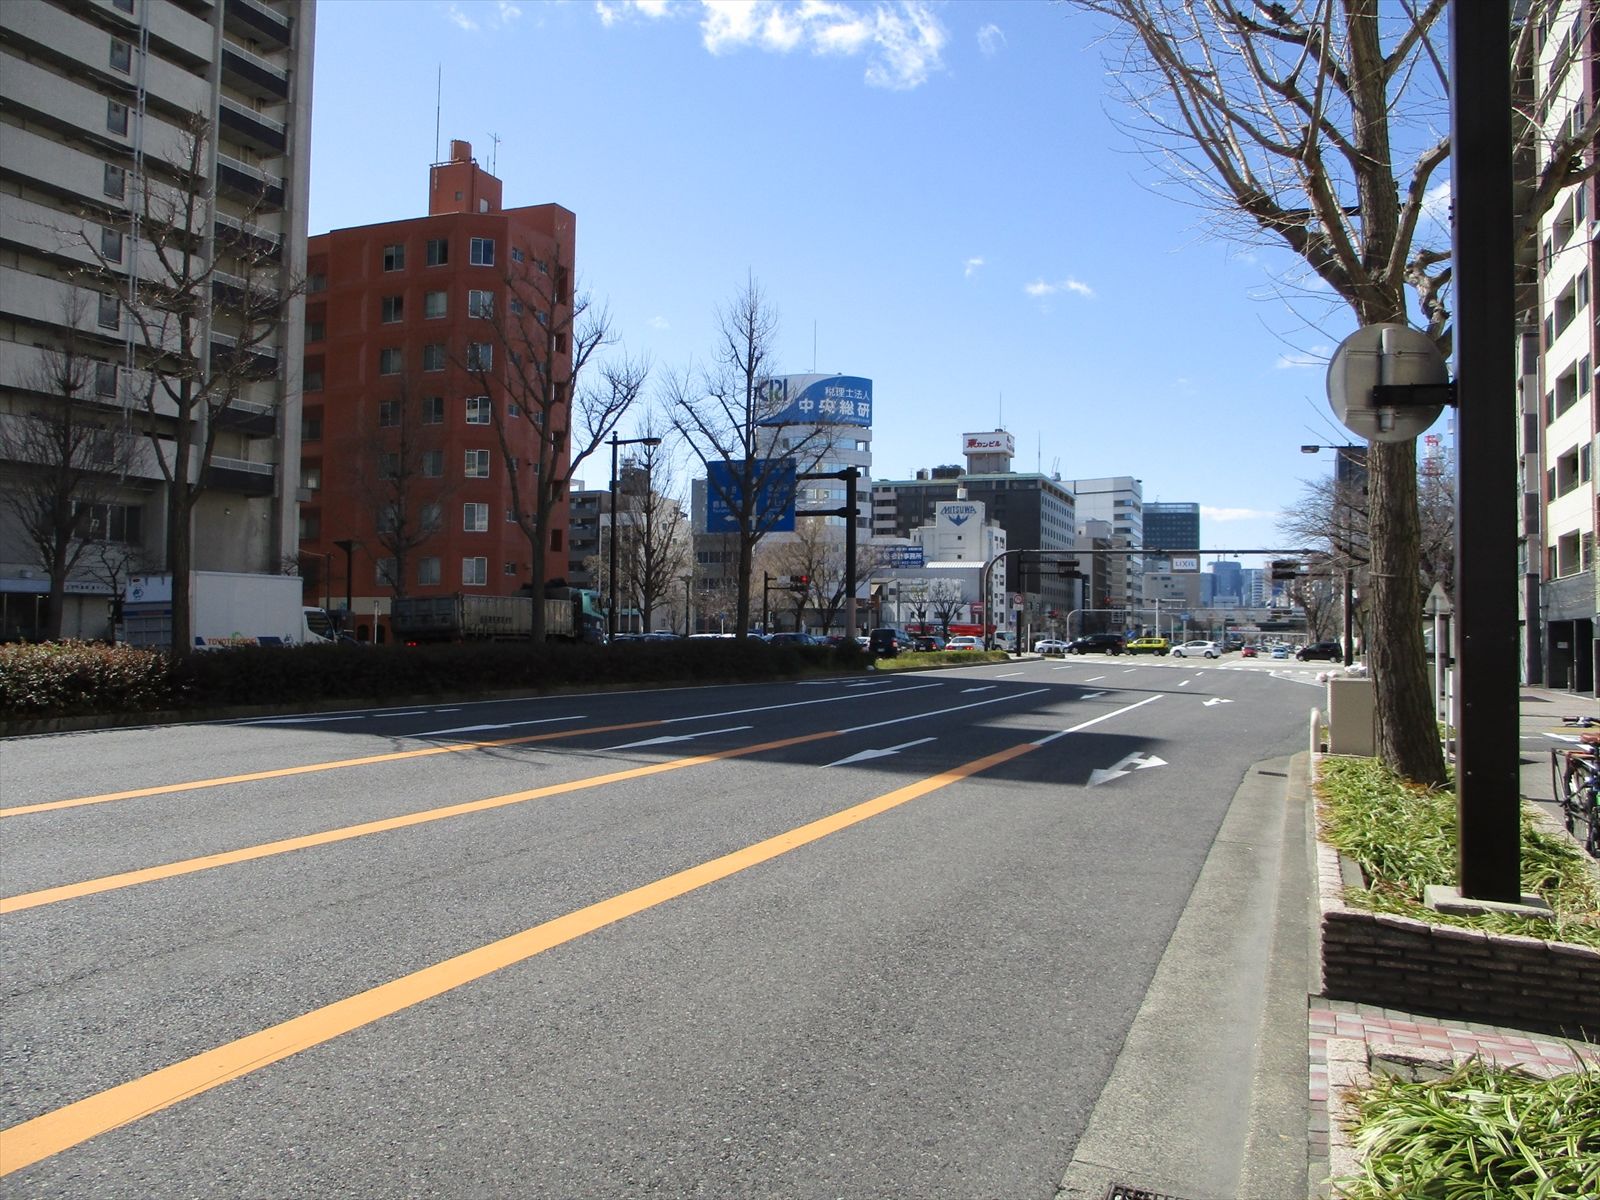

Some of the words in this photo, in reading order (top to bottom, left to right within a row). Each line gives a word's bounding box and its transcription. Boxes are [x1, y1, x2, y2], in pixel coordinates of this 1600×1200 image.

[825, 386, 870, 401] 税理士法人
[798, 398, 870, 418] 中央総研
[966, 438, 1002, 448] 東カンビル
[940, 505, 977, 514] MITSUWA
[1175, 560, 1195, 568] LIXIL
